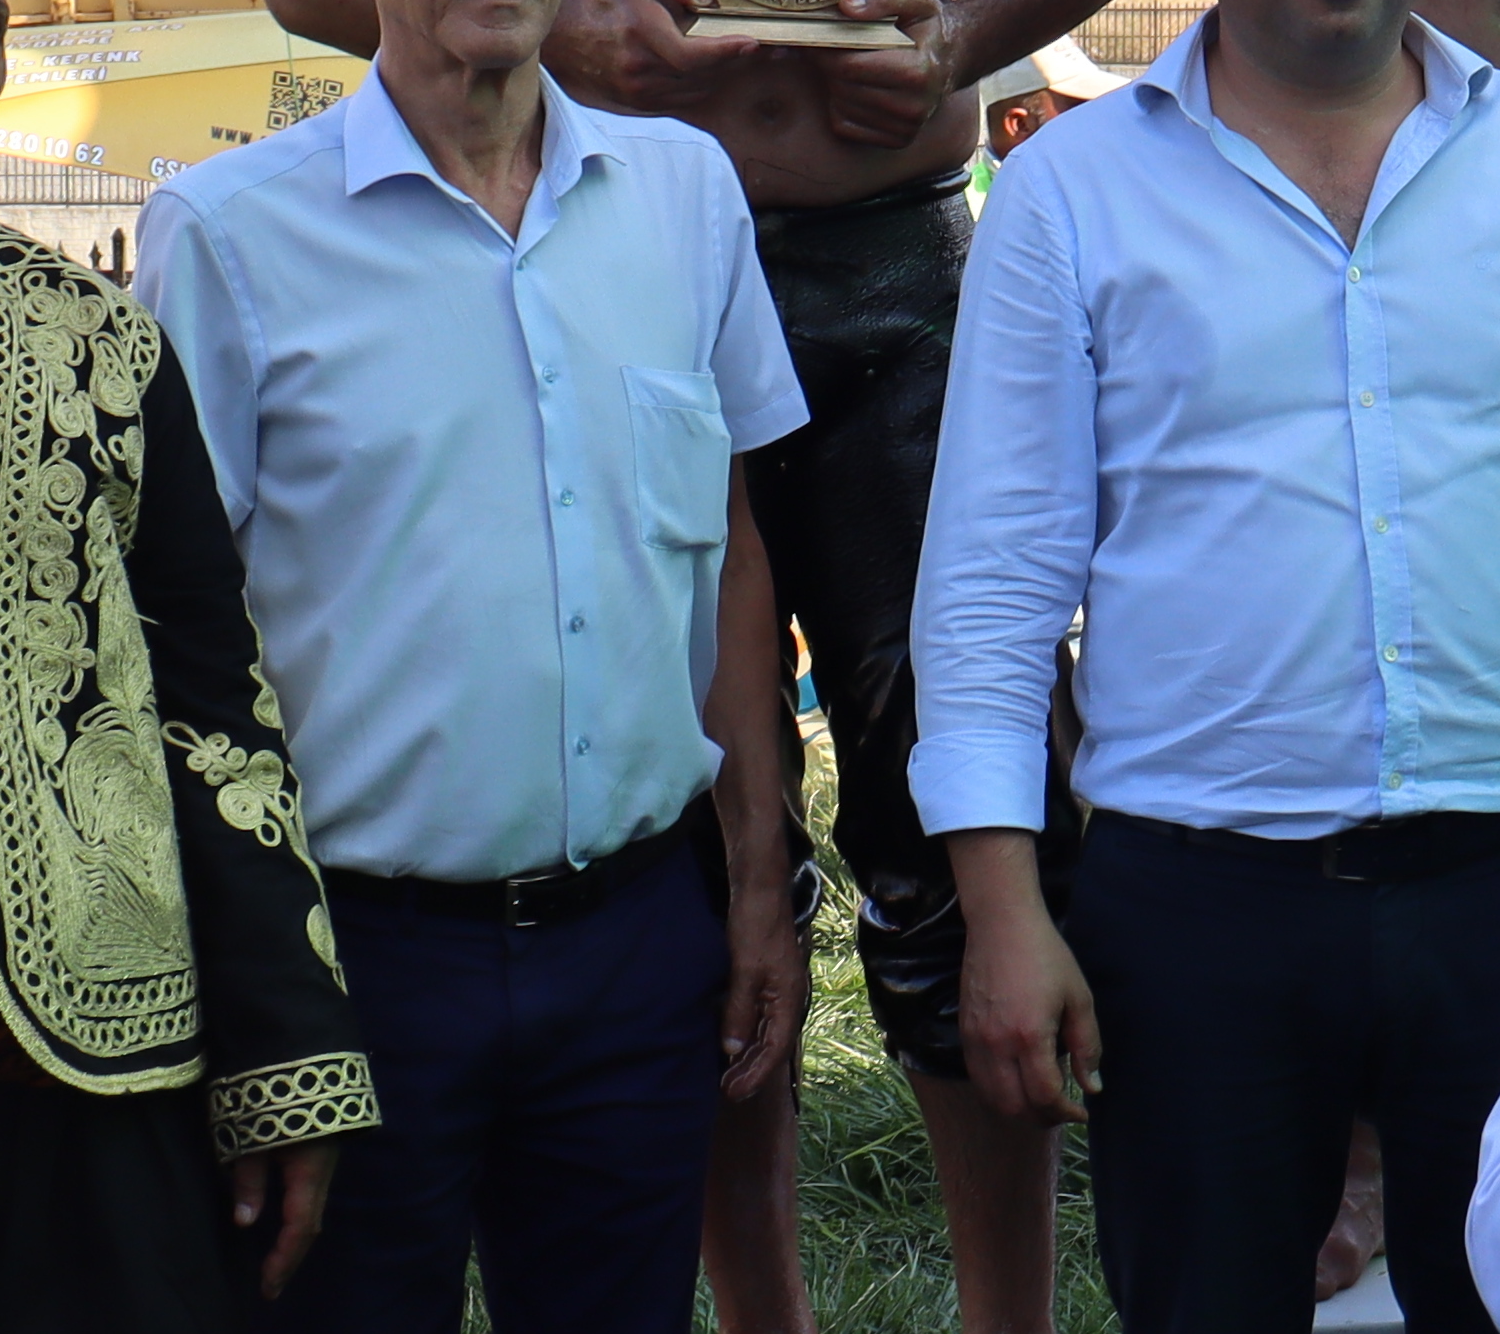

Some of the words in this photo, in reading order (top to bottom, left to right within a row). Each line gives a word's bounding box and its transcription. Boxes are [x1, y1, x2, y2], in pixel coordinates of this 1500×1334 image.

[42, 50, 142, 67] KEPENK
[43, 137, 69, 159] 10
[74, 143, 104, 165] 62
